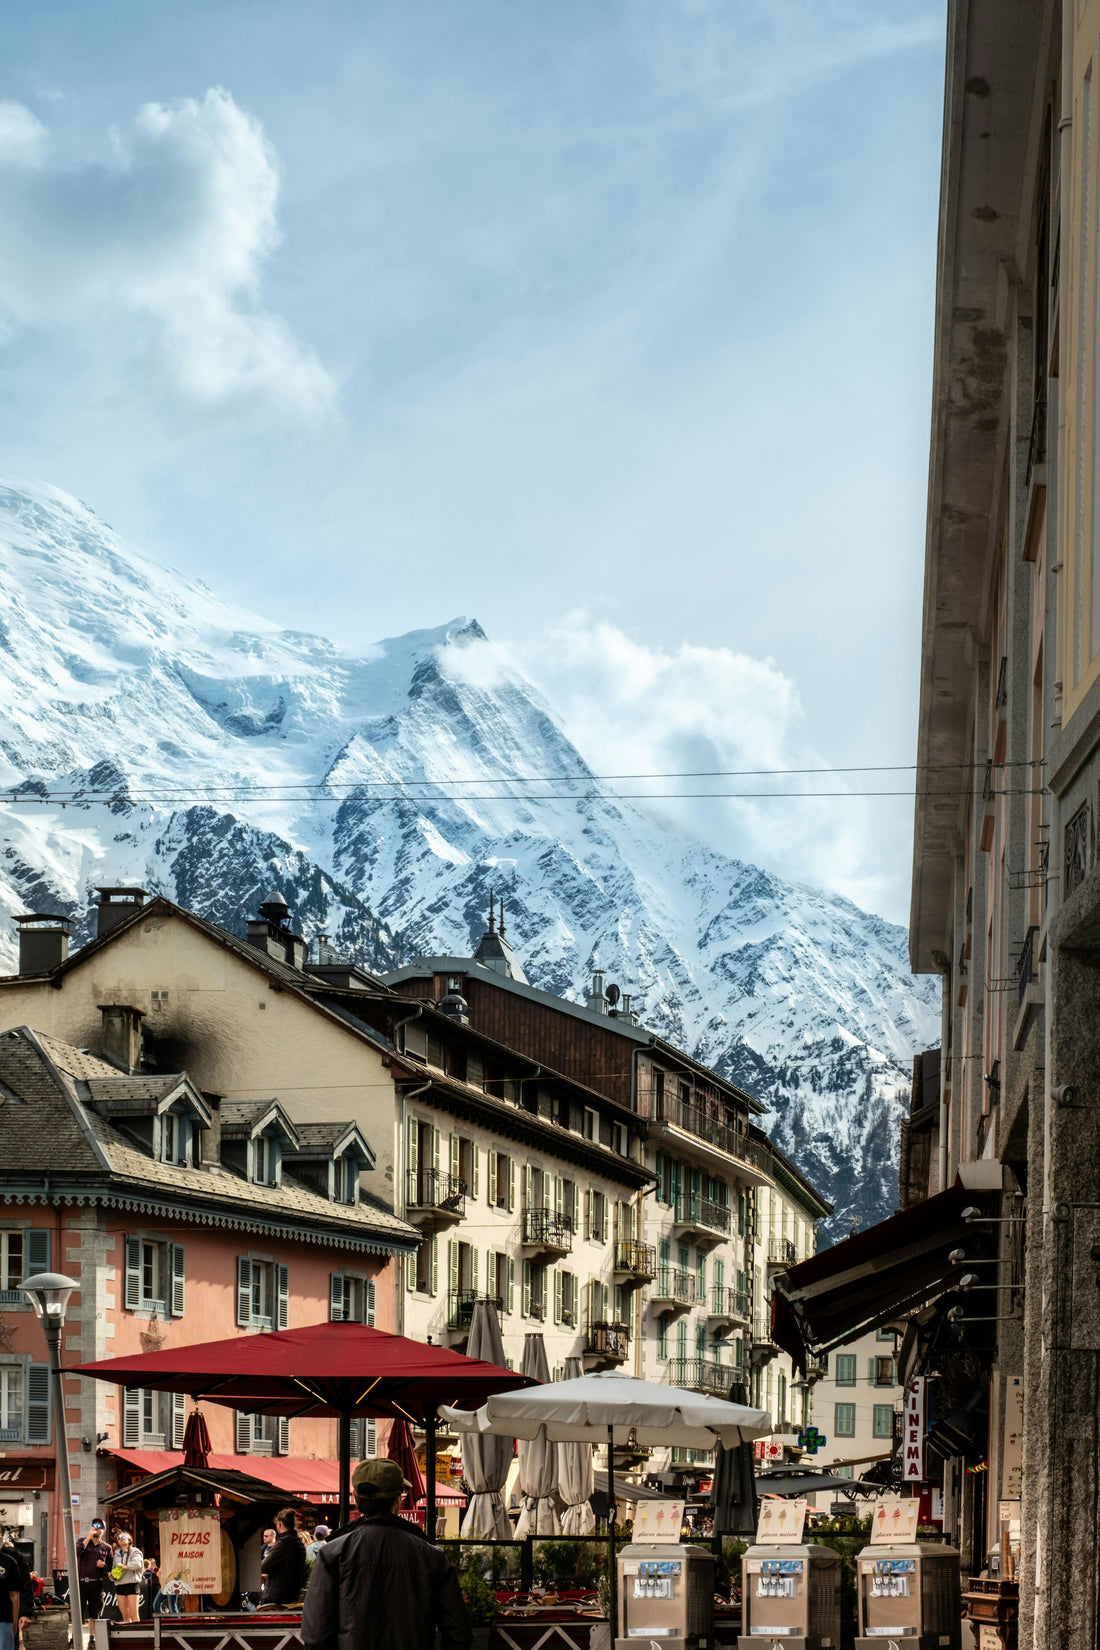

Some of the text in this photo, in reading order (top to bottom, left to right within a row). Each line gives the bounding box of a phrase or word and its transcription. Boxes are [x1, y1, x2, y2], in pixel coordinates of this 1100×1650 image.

[908, 1380, 920, 1476] CINEMA
[170, 1531, 211, 1545] PIZZAS
[178, 1551, 204, 1559] MAISON
